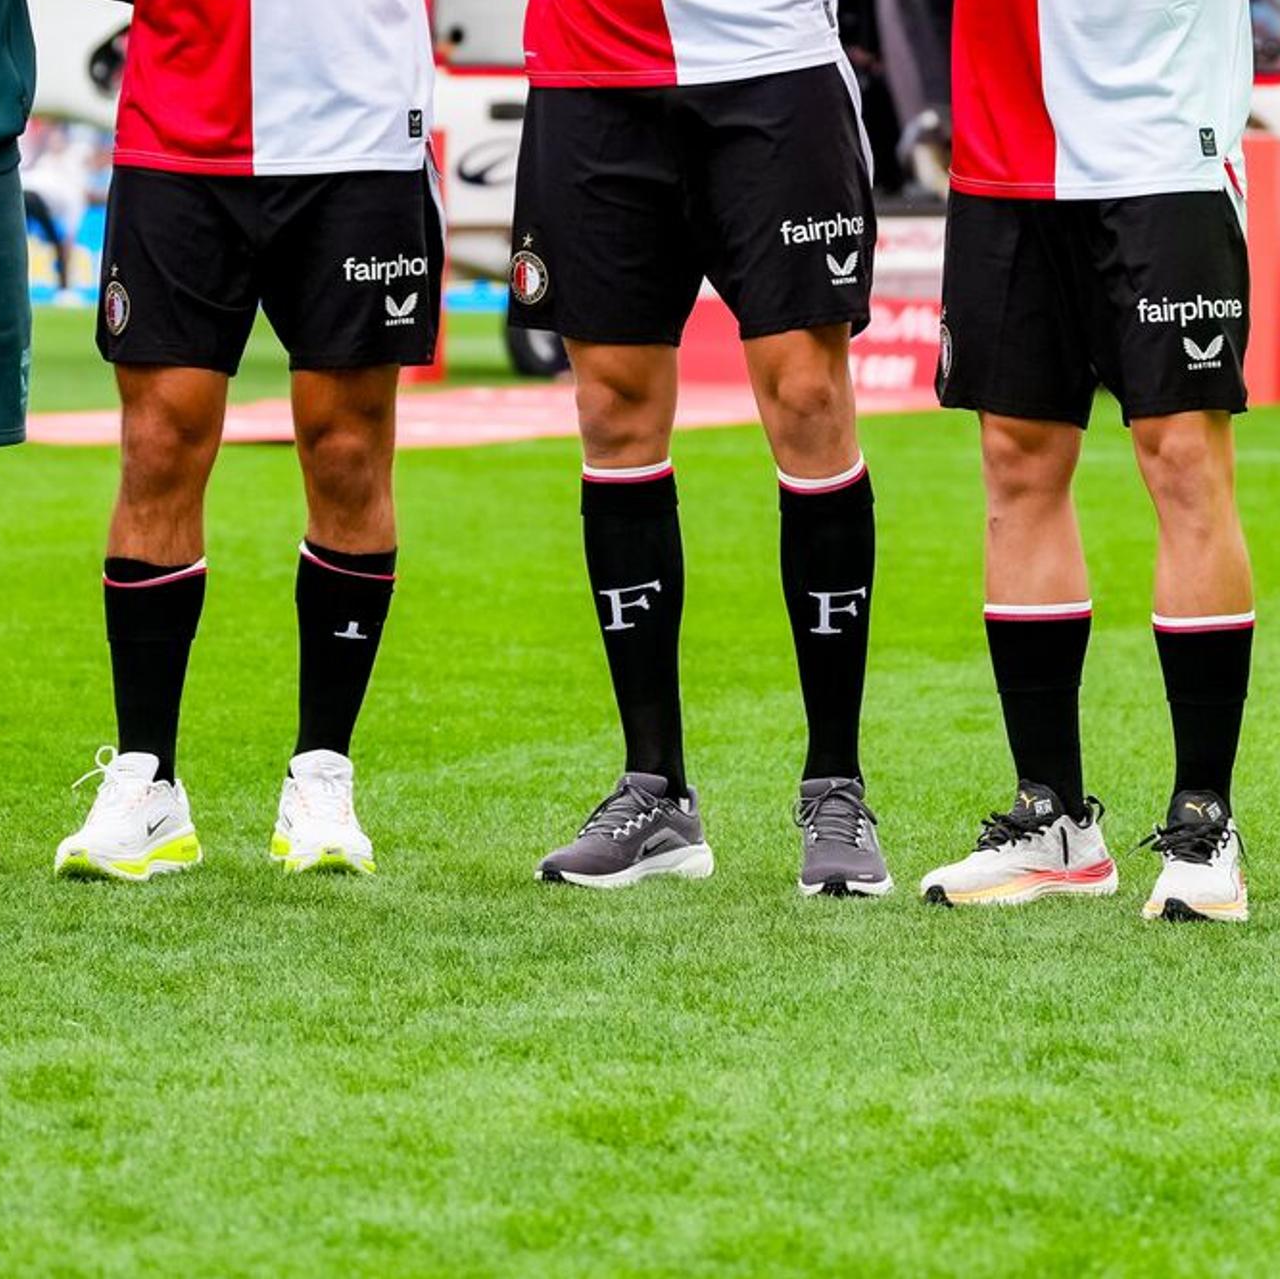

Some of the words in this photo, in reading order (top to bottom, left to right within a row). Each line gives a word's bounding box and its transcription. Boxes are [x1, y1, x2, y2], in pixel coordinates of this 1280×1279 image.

[780, 212, 864, 245] fairphoe
[1137, 294, 1242, 328] fairphone
[599, 579, 662, 631] F
[808, 586, 867, 634] F
